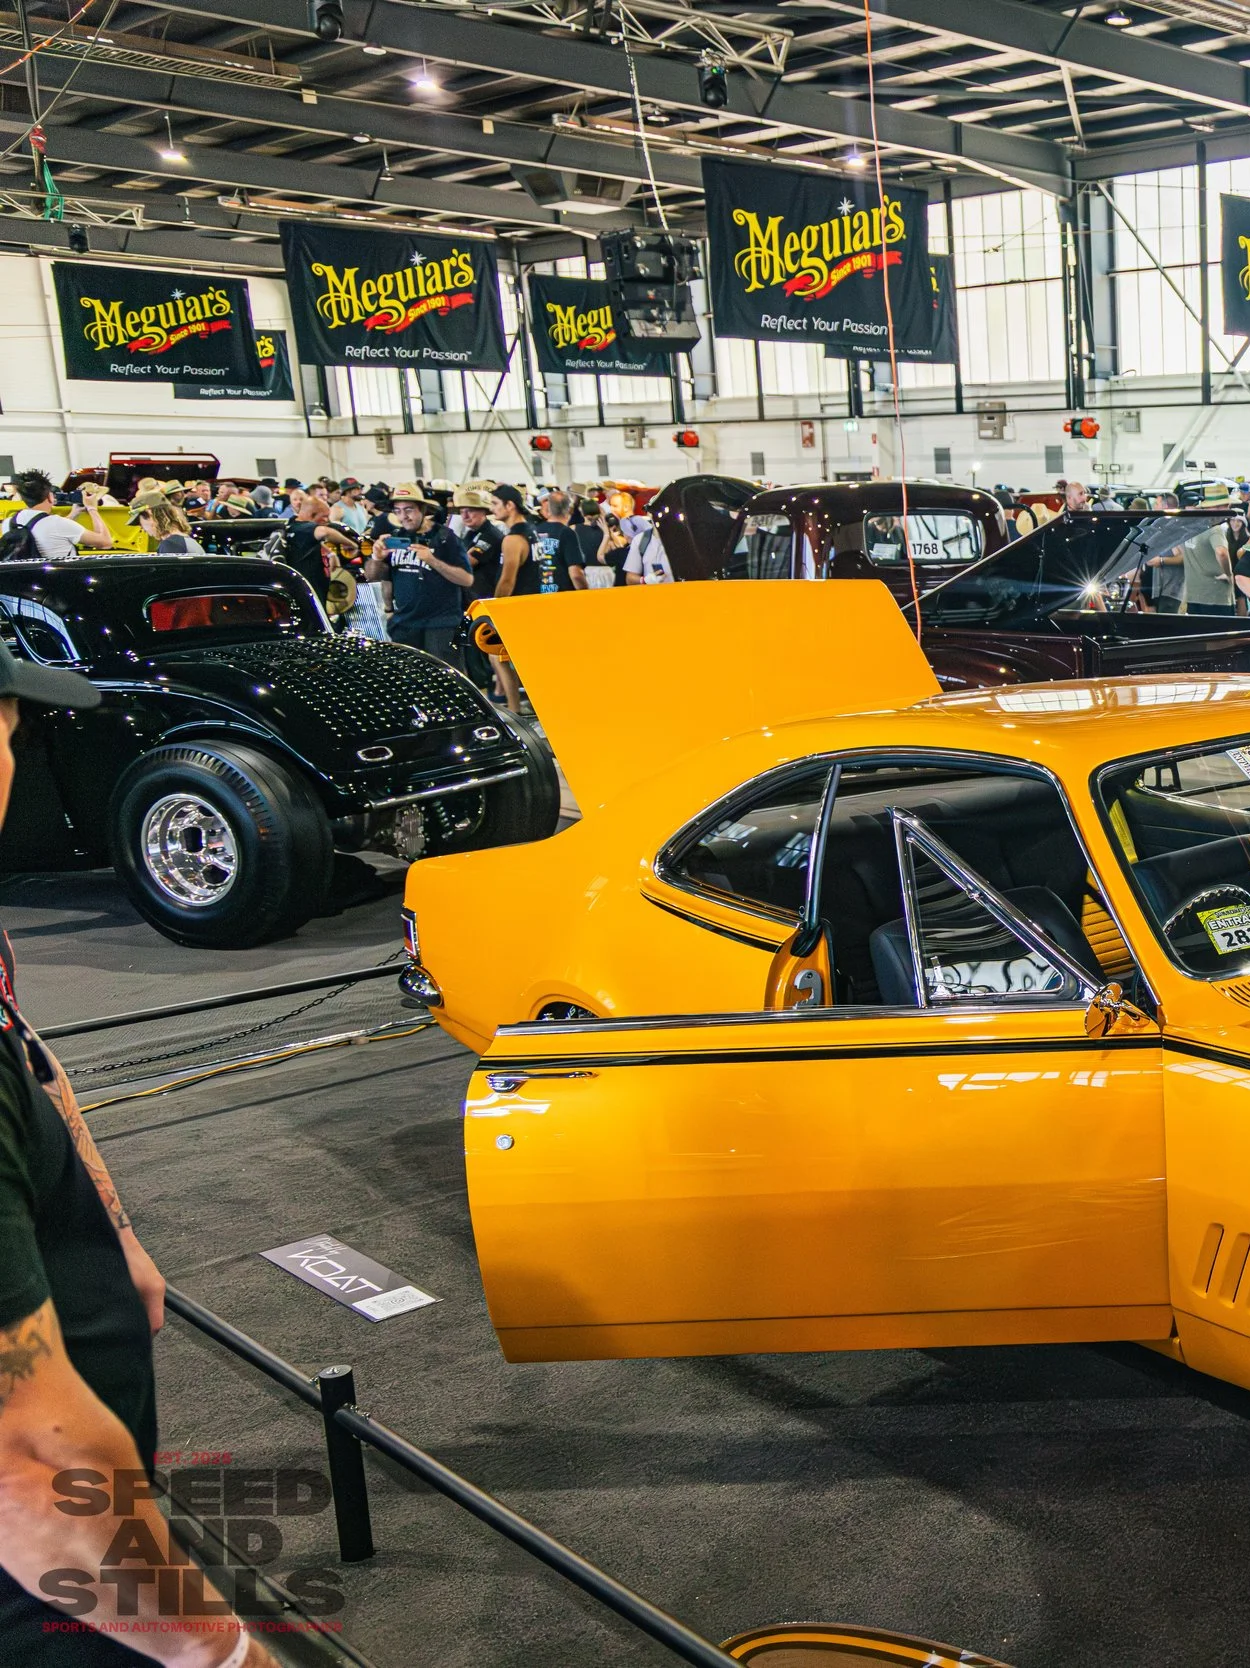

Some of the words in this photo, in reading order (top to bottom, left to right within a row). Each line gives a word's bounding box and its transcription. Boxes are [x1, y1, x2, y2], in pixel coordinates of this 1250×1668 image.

[733, 195, 905, 295] Meguiar's
[312, 248, 475, 330] Meguiar's
[80, 286, 231, 351] Meguiar's
[761, 314, 807, 332] Reflect
[812, 316, 839, 331] Your
[345, 345, 390, 360] Reflect
[393, 346, 419, 358] Your
[110, 363, 151, 376] Reflect
[155, 364, 181, 375] Your
[565, 359, 594, 370] Reflect
[596, 360, 613, 368] Your
[912, 543, 938, 555] 1768
[286, 1249, 383, 1293] KOAT
